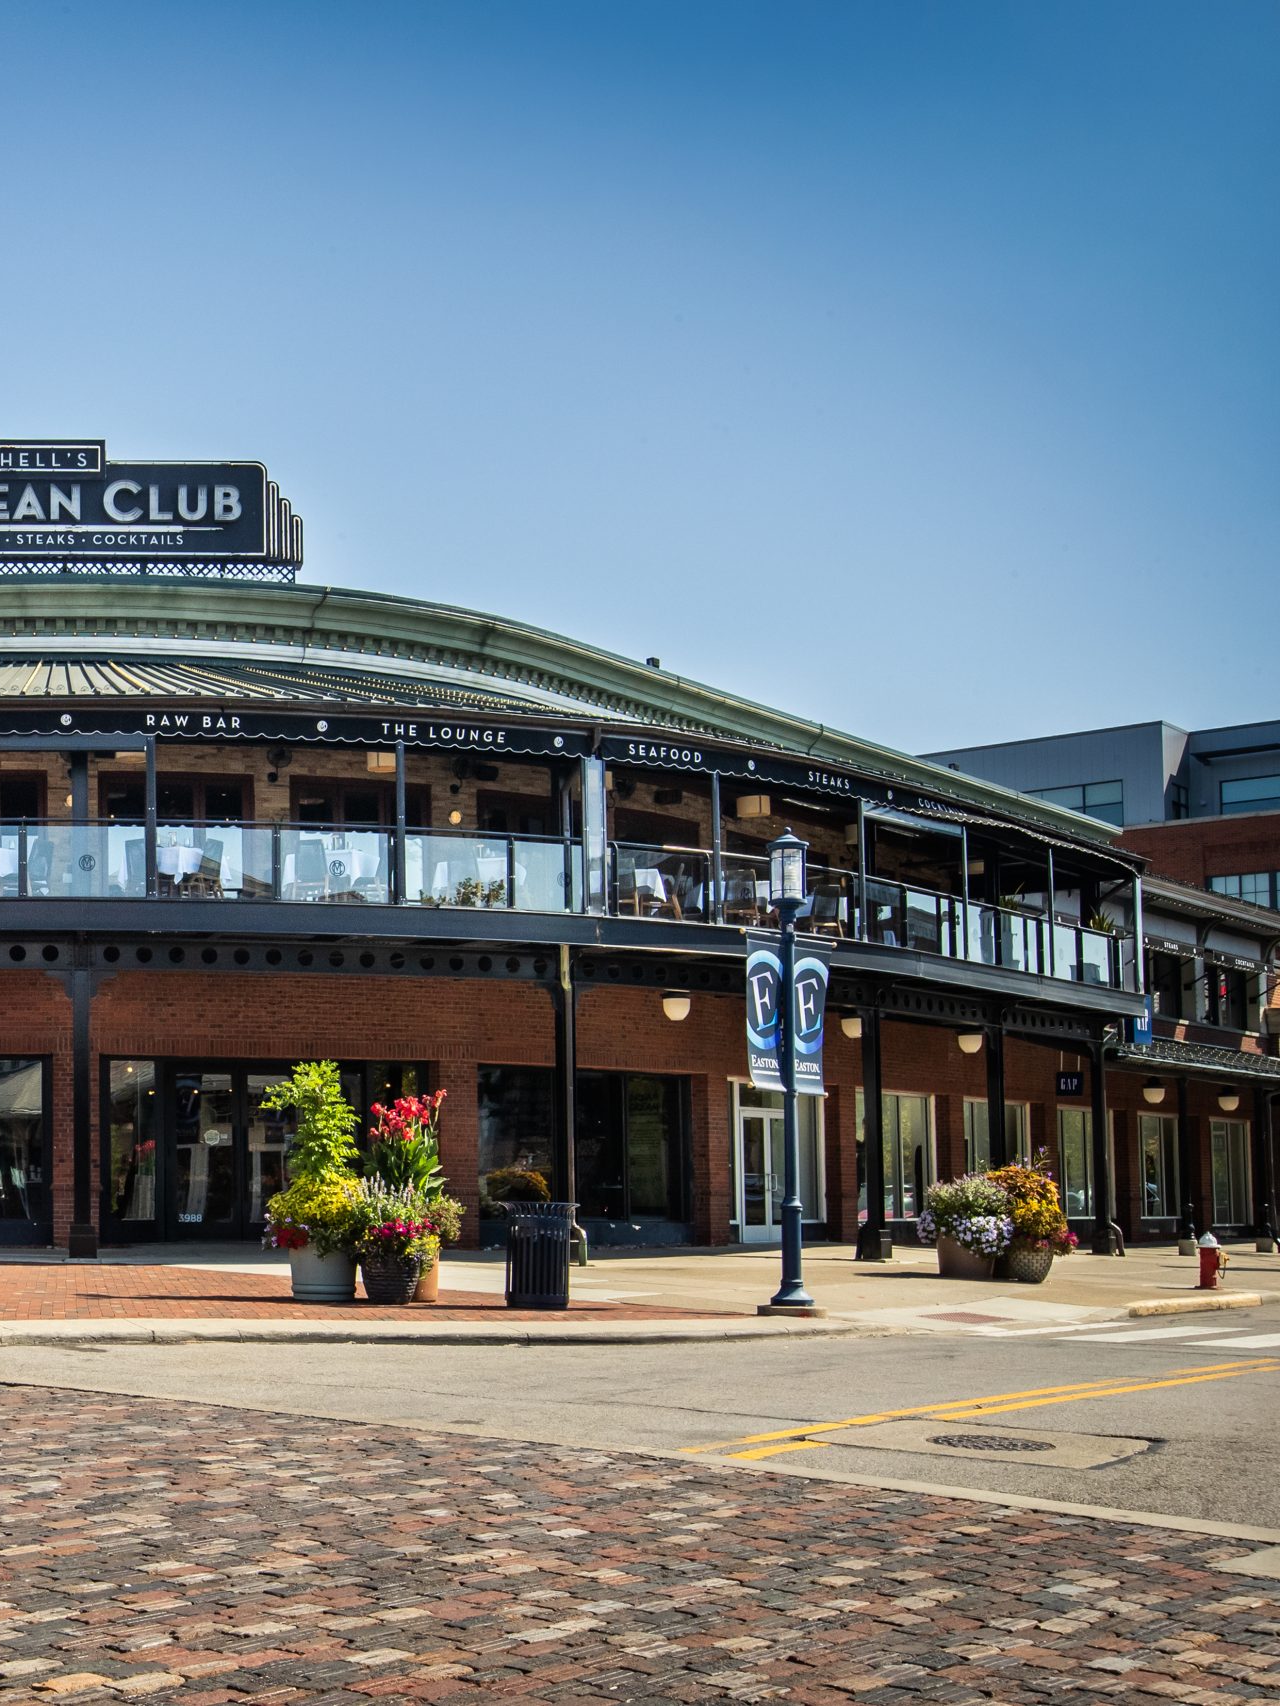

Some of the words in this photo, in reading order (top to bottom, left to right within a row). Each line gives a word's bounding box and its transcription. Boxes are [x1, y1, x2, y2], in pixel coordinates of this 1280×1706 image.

[103, 480, 243, 522] CLUB
[16, 534, 75, 545] STEAKS
[92, 534, 184, 546] COCKTAILS
[146, 714, 189, 727] RAW
[202, 716, 240, 729] BAR
[381, 723, 417, 736] THE
[430, 726, 506, 743] LOUNGE
[628, 743, 702, 763] SEAFOOD
[808, 771, 850, 789] STEAKS
[749, 971, 778, 1031] E
[795, 978, 821, 1036] E
[1060, 1078, 1078, 1090] GAP
[178, 1213, 203, 1223] 3988
